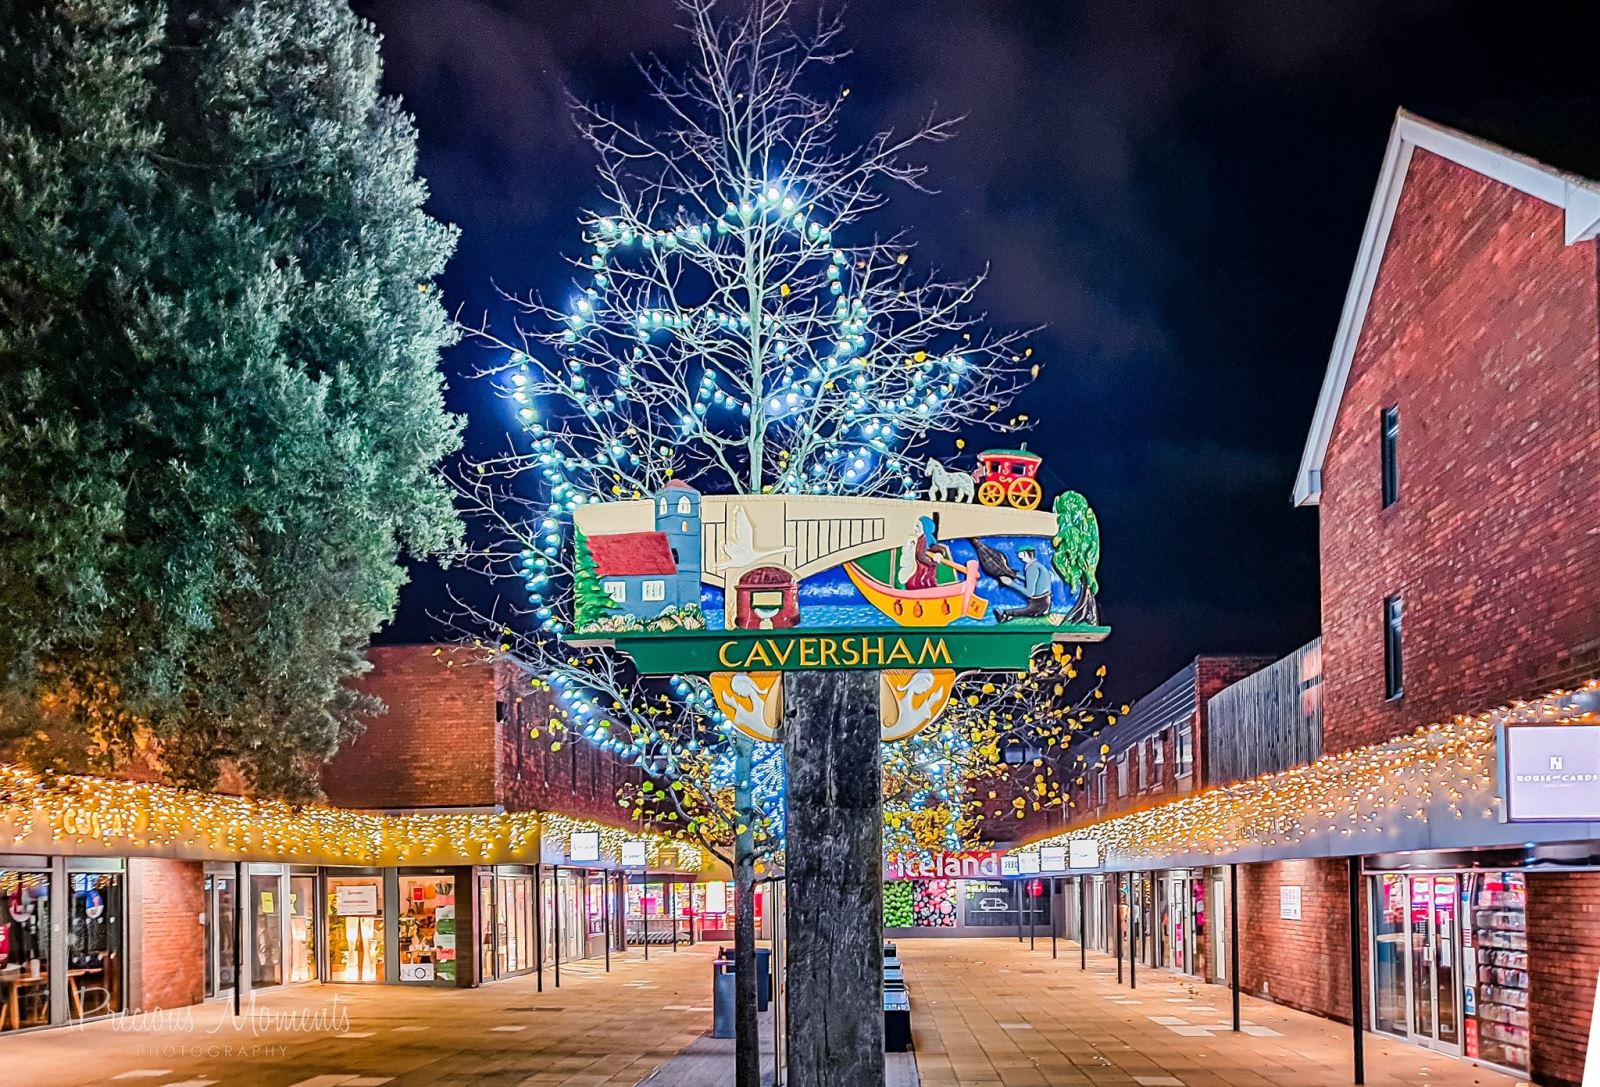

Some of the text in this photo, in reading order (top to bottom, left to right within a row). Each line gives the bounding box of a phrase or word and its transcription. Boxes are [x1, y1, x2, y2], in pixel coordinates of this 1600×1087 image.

[718, 637, 953, 668] CAVERSHAM
[1562, 774, 1599, 782] CARDS
[63, 808, 123, 839] COSA
[897, 853, 998, 877] iceland
